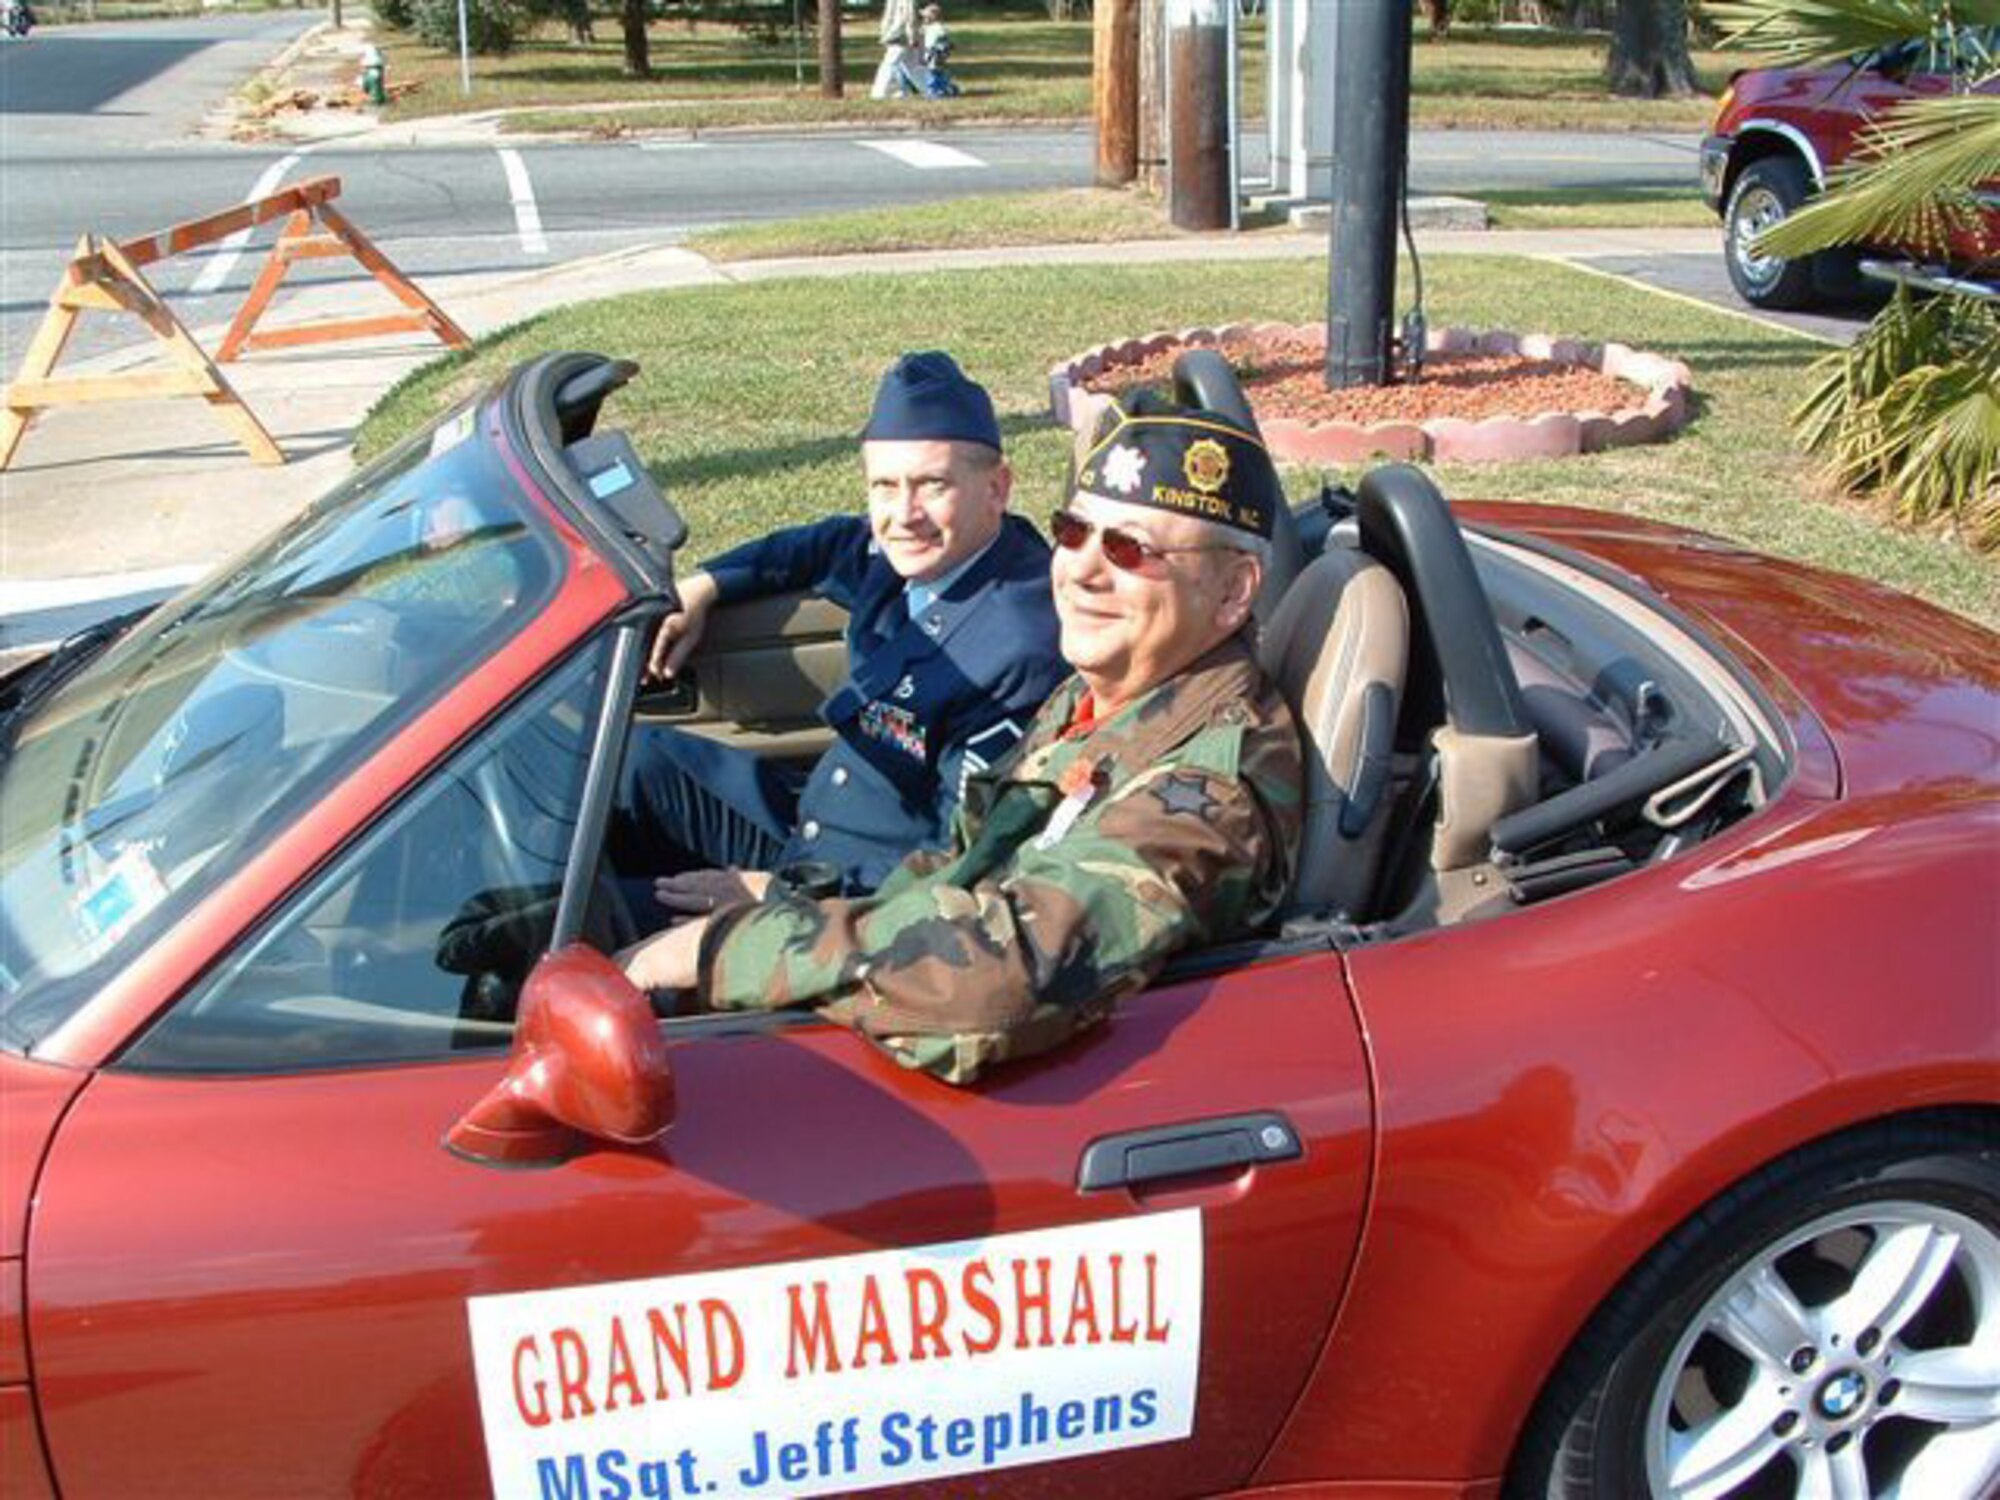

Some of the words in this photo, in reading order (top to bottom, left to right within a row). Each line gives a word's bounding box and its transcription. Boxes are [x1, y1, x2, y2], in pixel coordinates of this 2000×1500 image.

[512, 1298, 745, 1427] GRAND
[785, 1253, 1171, 1379] MARSHALL
[739, 1417, 858, 1488] Jeff
[881, 1388, 1157, 1463] Stephens
